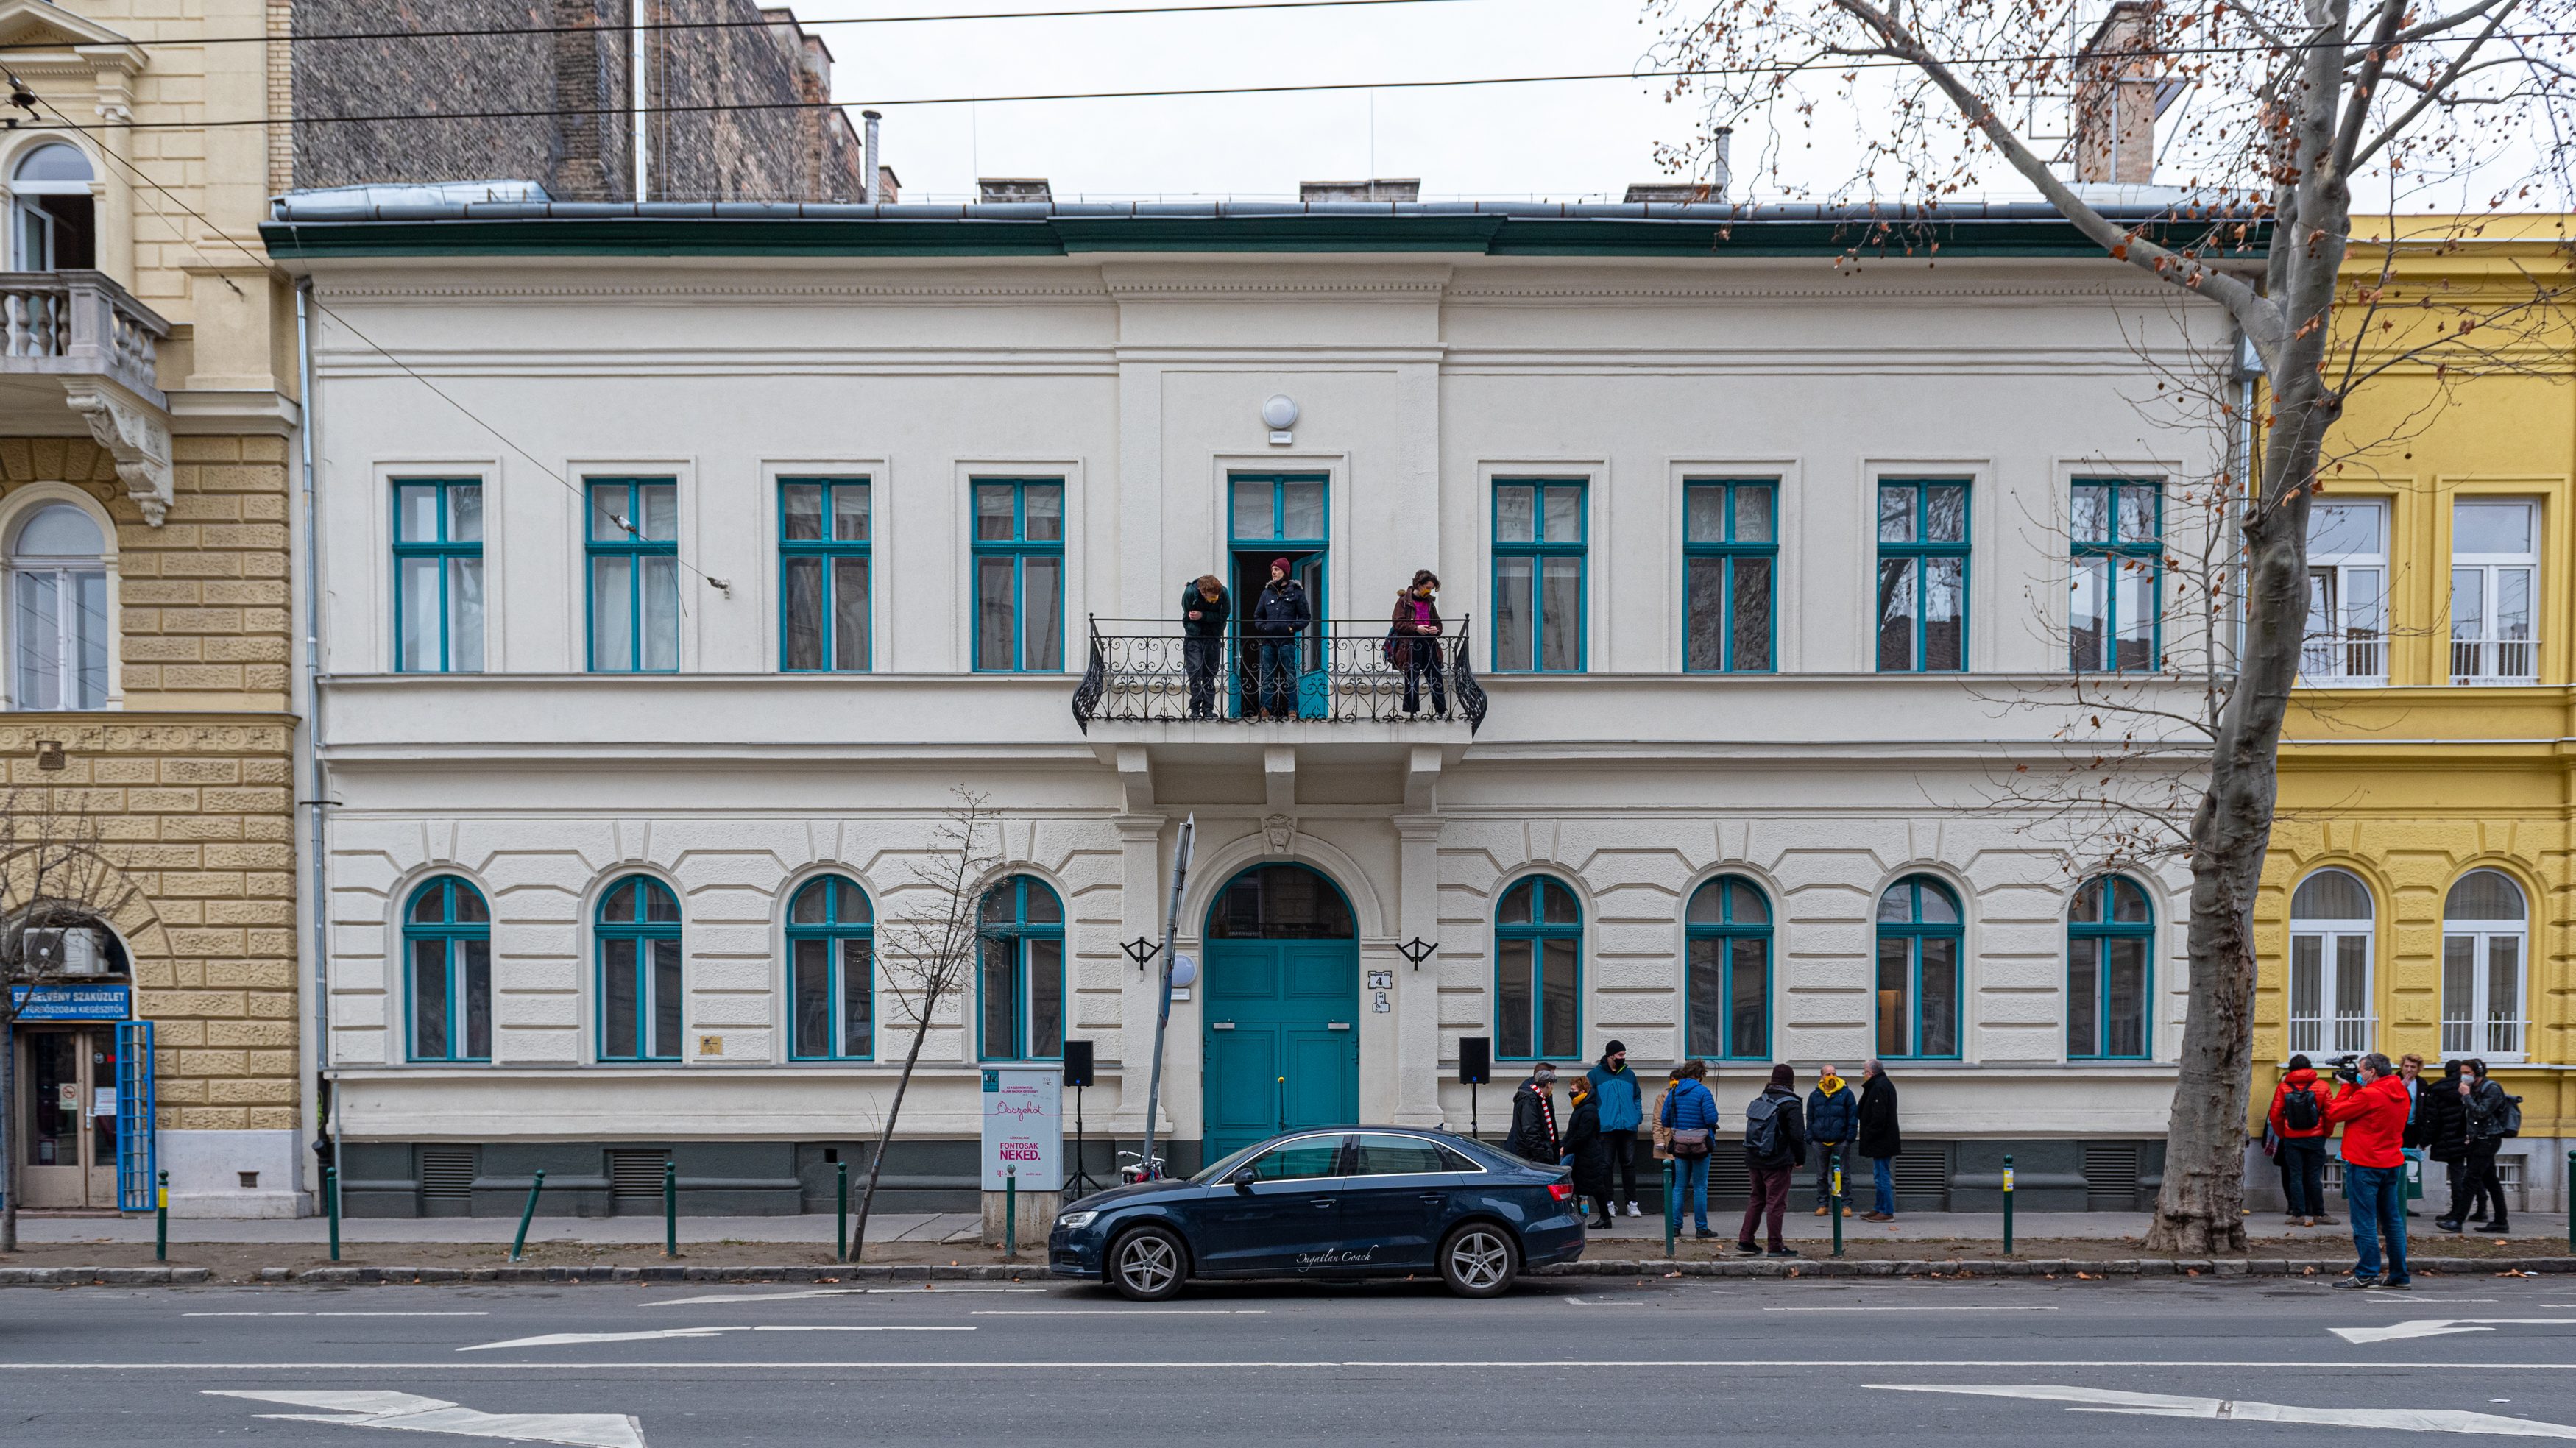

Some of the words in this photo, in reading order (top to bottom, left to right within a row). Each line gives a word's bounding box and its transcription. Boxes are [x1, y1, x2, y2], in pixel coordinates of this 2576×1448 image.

[1376, 977, 1382, 985] 4
[14, 990, 71, 1001] SZRELVÉNY
[73, 990, 124, 1001] SZAKÜZLET
[997, 1101, 1042, 1121] Összeköt
[1000, 1150, 1041, 1160] NEKED.
[1296, 1248, 1340, 1272] Ingatlan
[1342, 1244, 1379, 1261] Coach
